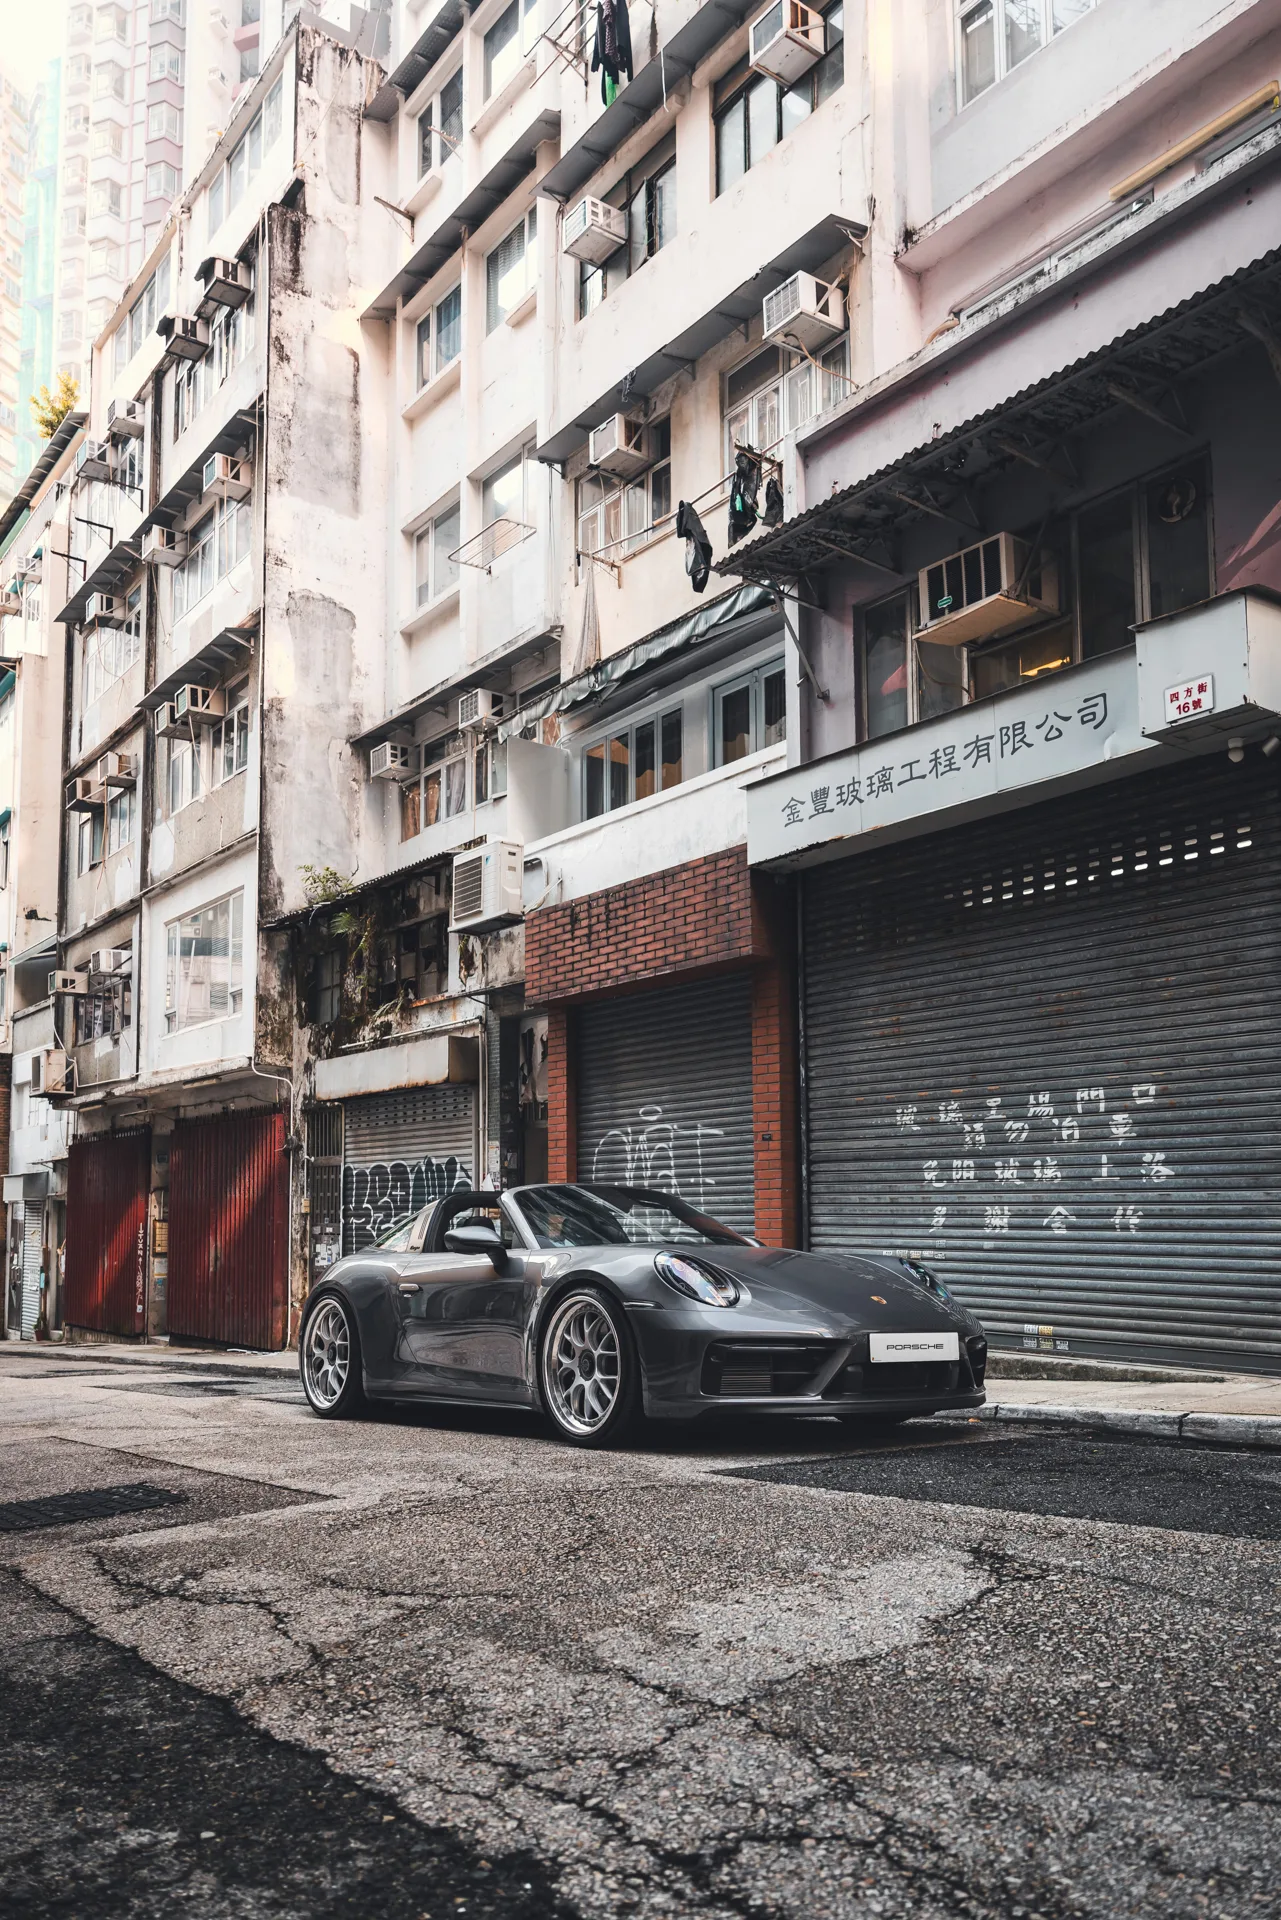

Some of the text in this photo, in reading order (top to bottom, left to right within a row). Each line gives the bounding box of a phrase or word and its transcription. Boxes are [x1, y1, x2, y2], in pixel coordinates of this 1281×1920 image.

[1169, 682, 1208, 703] 四方街
[1176, 698, 1203, 715] 16號
[781, 692, 1108, 828] 金豐玻璃工程有限公司
[886, 1343, 944, 1351] PORSCHE
